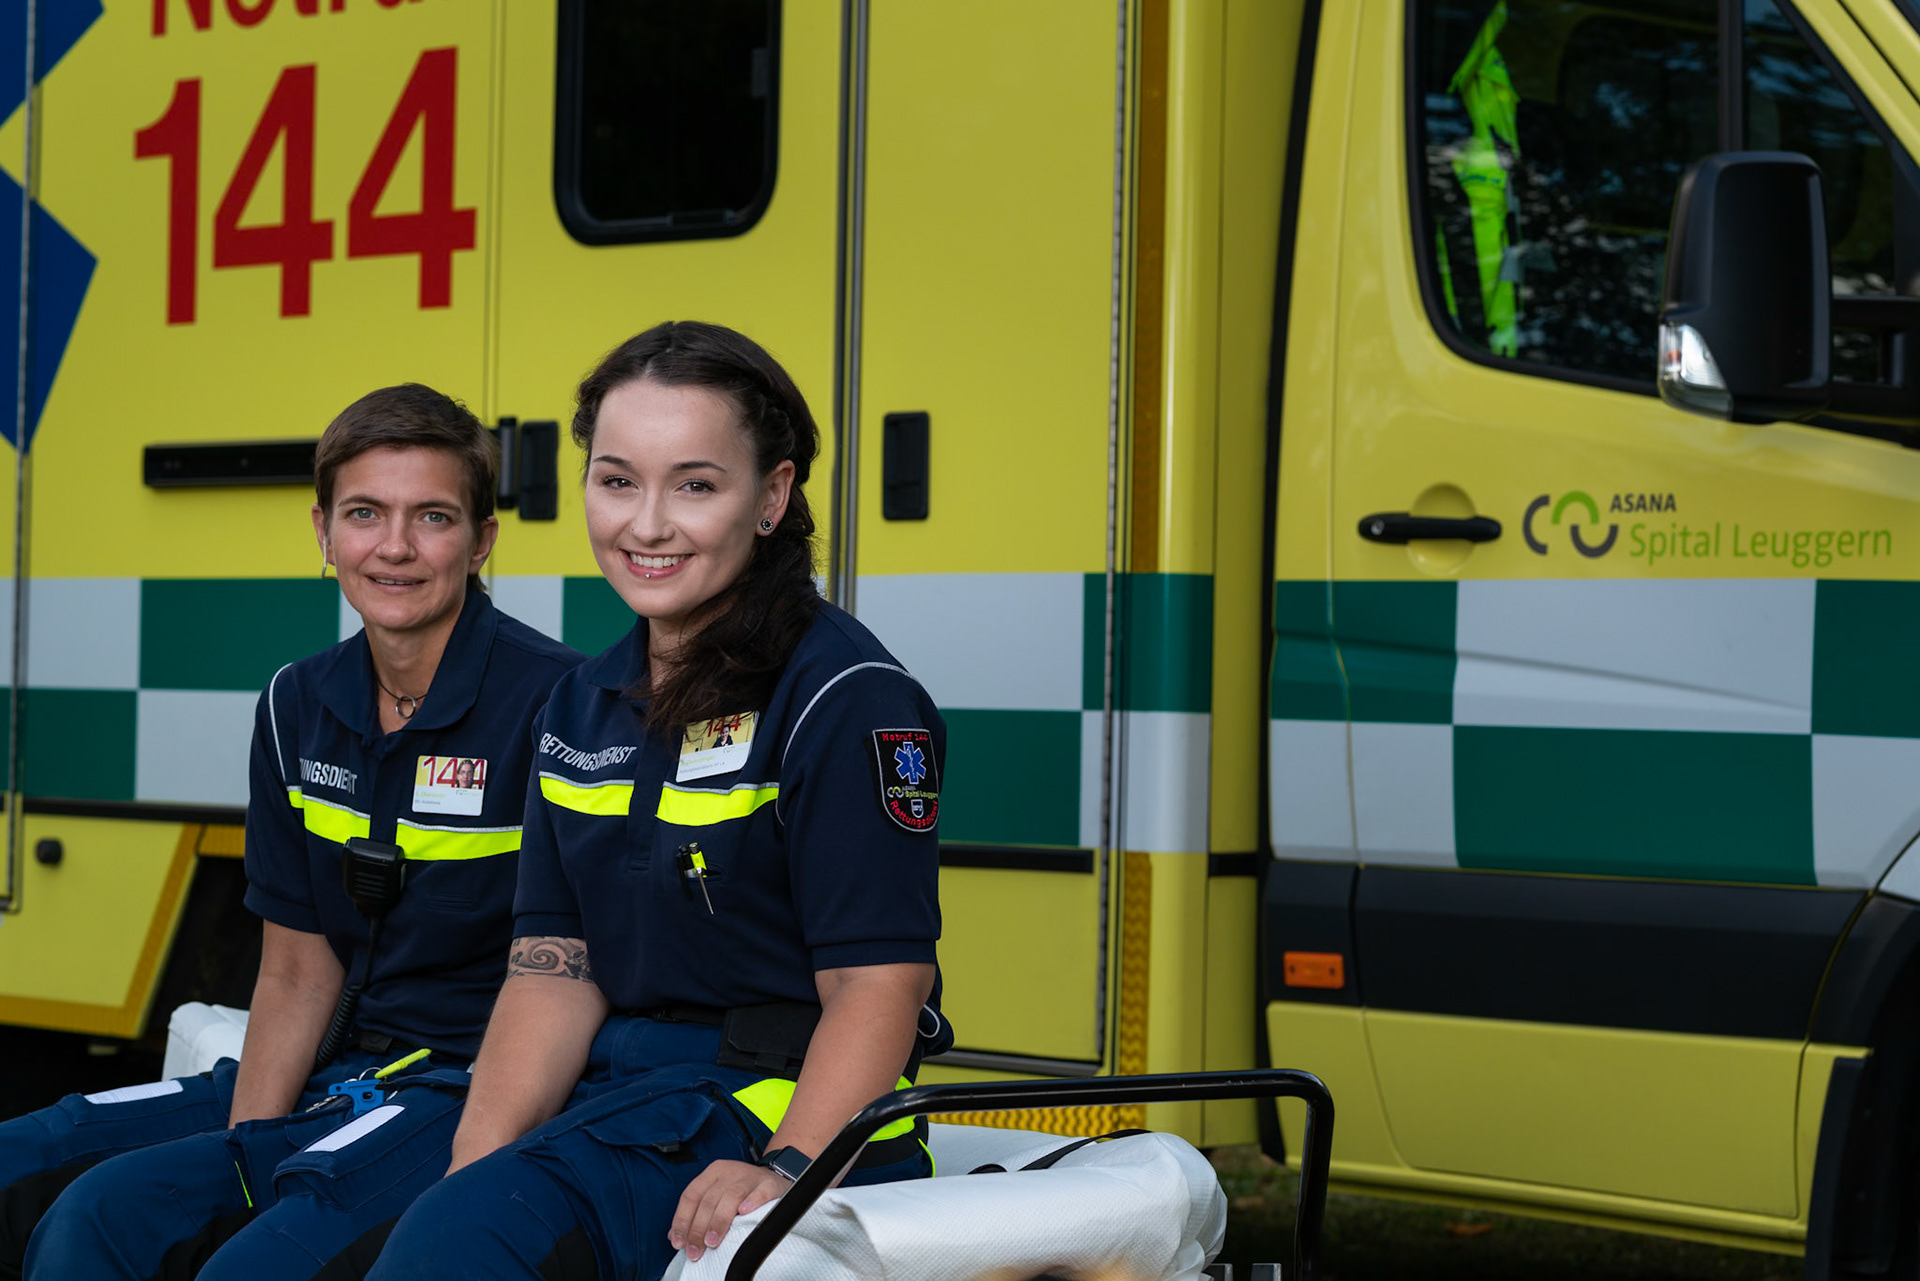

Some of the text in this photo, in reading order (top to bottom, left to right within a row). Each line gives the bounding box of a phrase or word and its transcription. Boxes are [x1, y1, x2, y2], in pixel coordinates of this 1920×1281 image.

[135, 45, 477, 326] 144
[1610, 493, 1677, 513] ASANA
[1628, 521, 1893, 568] Spital Leuggern
[882, 733, 912, 741] Notruf
[423, 756, 486, 790] 144
